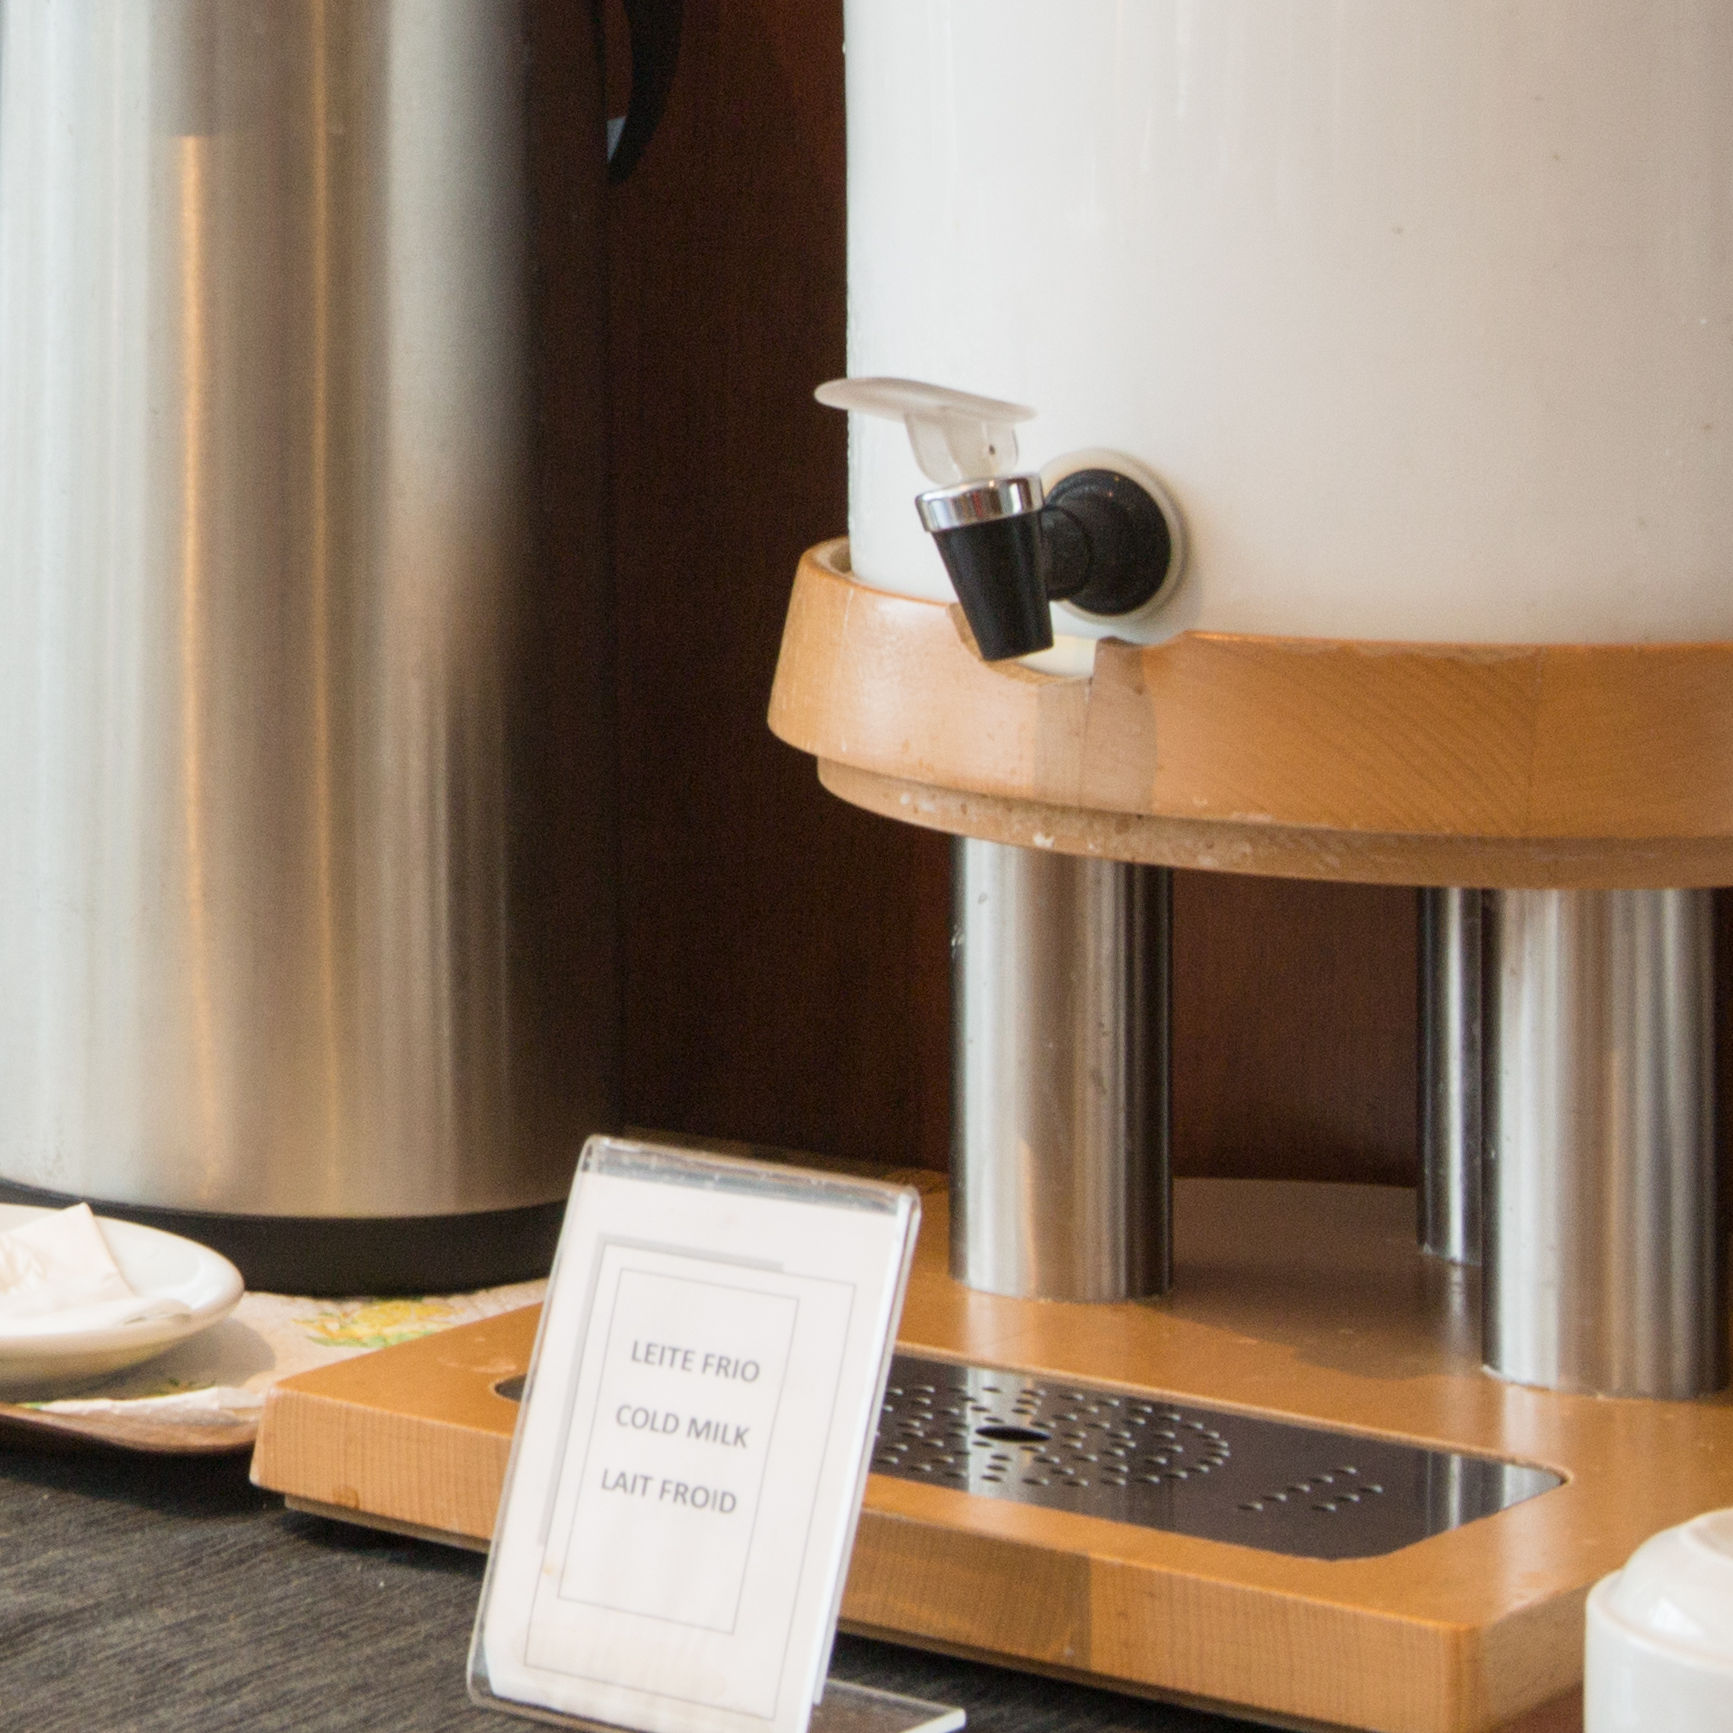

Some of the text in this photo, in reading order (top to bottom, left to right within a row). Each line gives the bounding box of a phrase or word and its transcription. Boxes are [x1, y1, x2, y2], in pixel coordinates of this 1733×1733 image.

[632, 1340, 762, 1384] LEITE FRIO
[616, 1404, 750, 1449] COLD MILK
[601, 1469, 738, 1515] LAIT FROID
